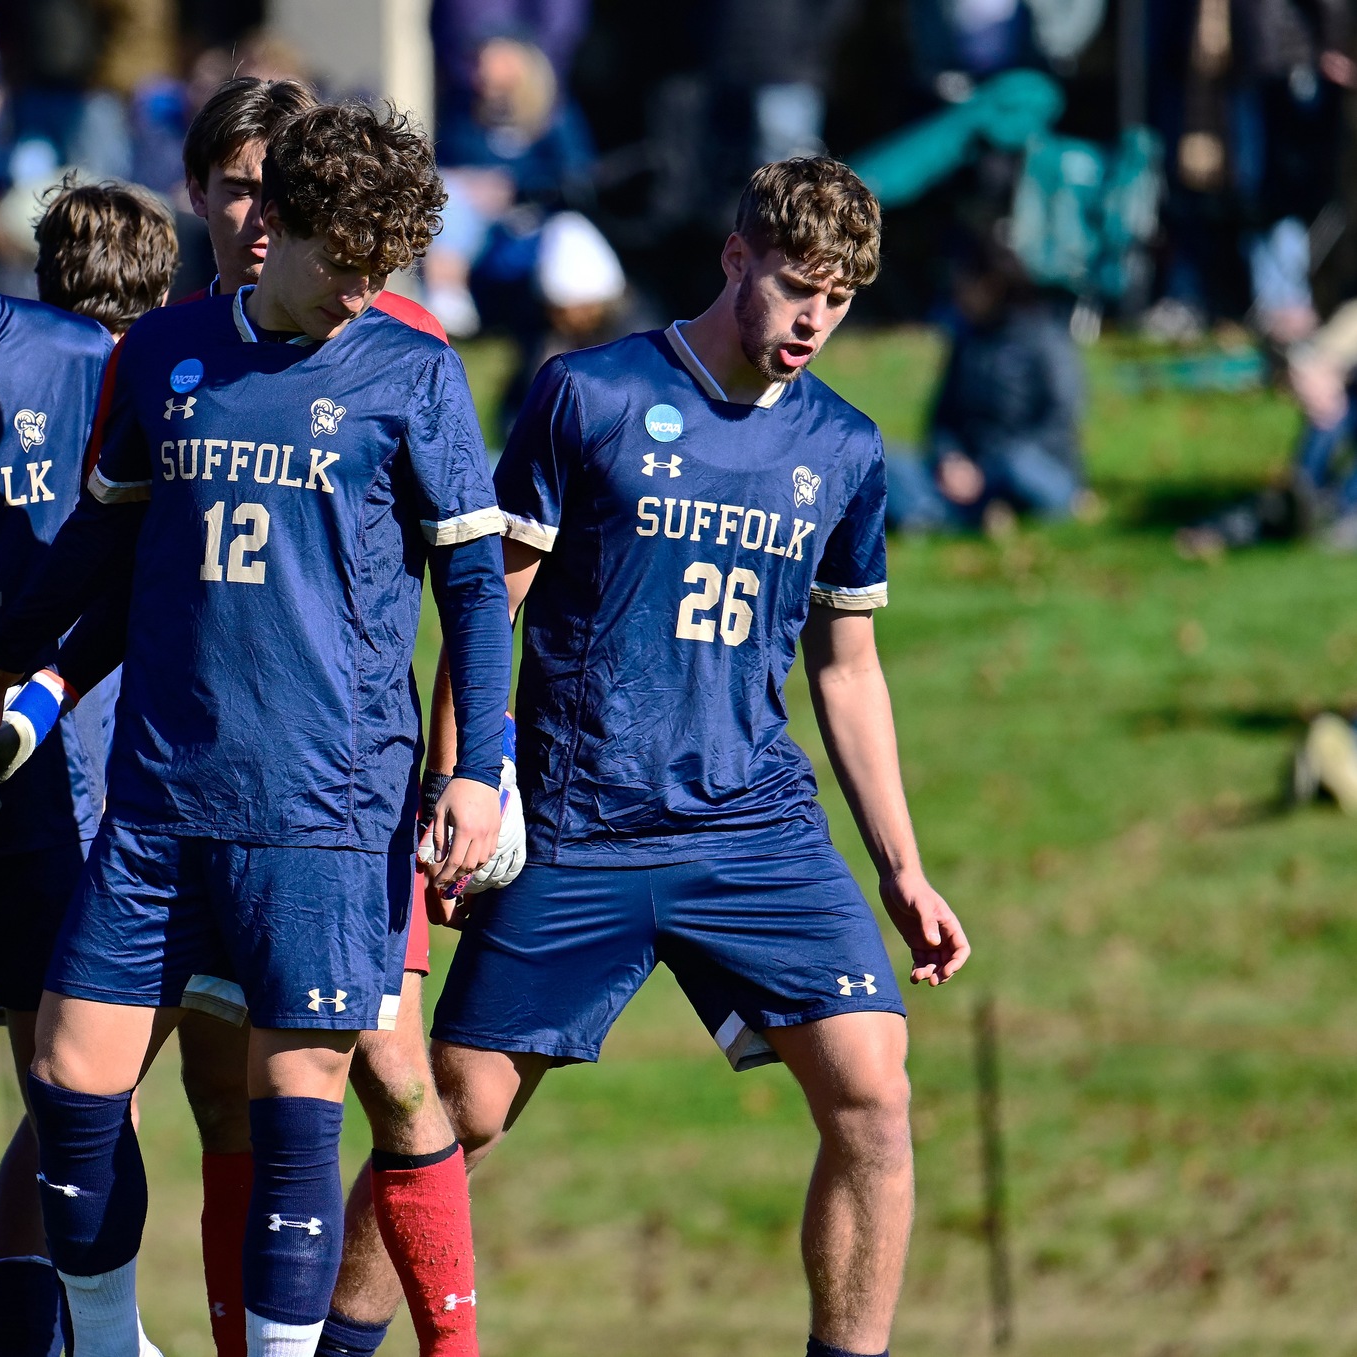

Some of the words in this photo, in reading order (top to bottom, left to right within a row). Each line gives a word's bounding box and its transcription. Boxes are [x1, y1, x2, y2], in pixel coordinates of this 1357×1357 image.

[172, 374, 201, 385] NCAA
[649, 421, 682, 433] NCAA
[160, 438, 341, 494] SUFFOLK
[199, 500, 271, 585] 12
[636, 496, 816, 562] SUFFOLK
[675, 561, 761, 647] 26
